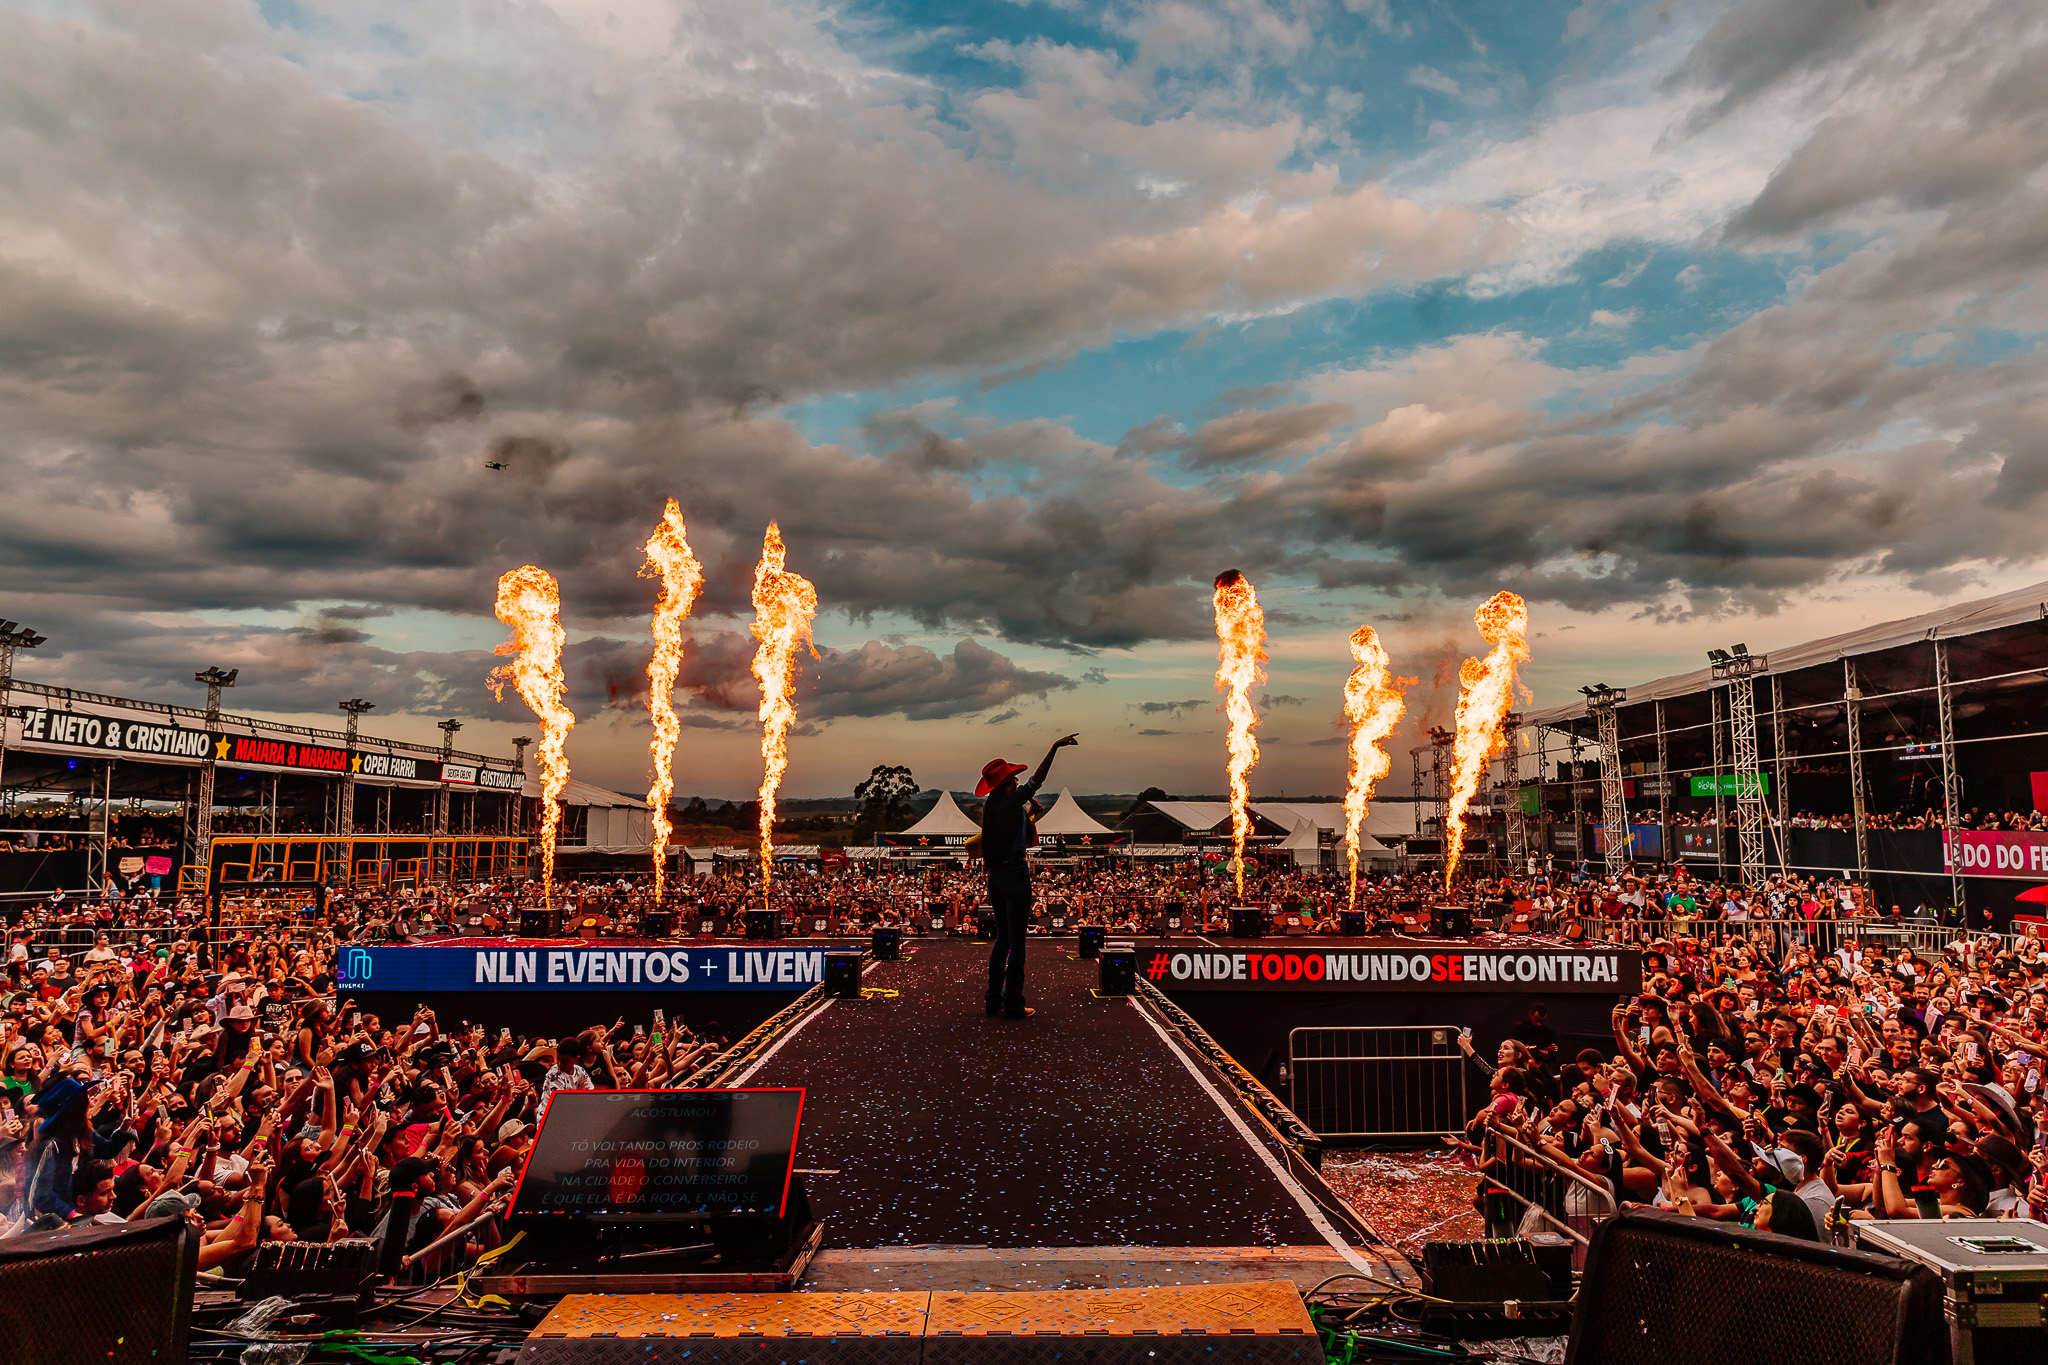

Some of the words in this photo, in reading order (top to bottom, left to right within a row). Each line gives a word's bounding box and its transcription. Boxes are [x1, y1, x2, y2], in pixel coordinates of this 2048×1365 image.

[23, 708, 47, 740] ZÉ
[50, 713, 102, 745] NETO
[104, 721, 122, 748] &
[125, 724, 210, 757] CRISTIANO
[234, 738, 285, 764] MAIARA
[286, 744, 297, 766] &
[298, 745, 347, 771] MARAISA
[363, 754, 390, 775] OPEN
[390, 757, 416, 778] FARRA
[944, 836, 968, 845] WHIS
[1995, 844, 2024, 870] DO
[475, 951, 537, 983] NLN
[547, 951, 690, 984] EVENTOS
[728, 951, 828, 983] LIVEM
[1146, 953, 1619, 983] #ONDETODOMUNDOSEENCONTRA!
[630, 1107, 717, 1118] ACOSTUMOU
[570, 1139, 589, 1151] TÔ
[592, 1141, 666, 1151] VOLTANDO
[669, 1140, 704, 1150] PROS
[707, 1139, 759, 1150] RODEIO
[584, 1158, 610, 1168] PRA
[615, 1158, 645, 1168] VIDA
[649, 1158, 670, 1168] DO
[673, 1157, 736, 1167] INTERIOR
[561, 1176, 581, 1186] NA
[585, 1175, 635, 1186] CIDADE
[638, 1175, 650, 1185] O
[653, 1174, 748, 1185] CONVERSEIRO
[541, 1191, 551, 1204] É
[554, 1193, 584, 1206] QUE
[587, 1193, 611, 1204] ELA
[615, 1191, 624, 1203] É
[627, 1193, 646, 1204] DA
[650, 1192, 690, 1206] ROÇA,
[695, 1192, 703, 1203] E
[707, 1190, 739, 1203] NÃO
[741, 1192, 758, 1202] SE
